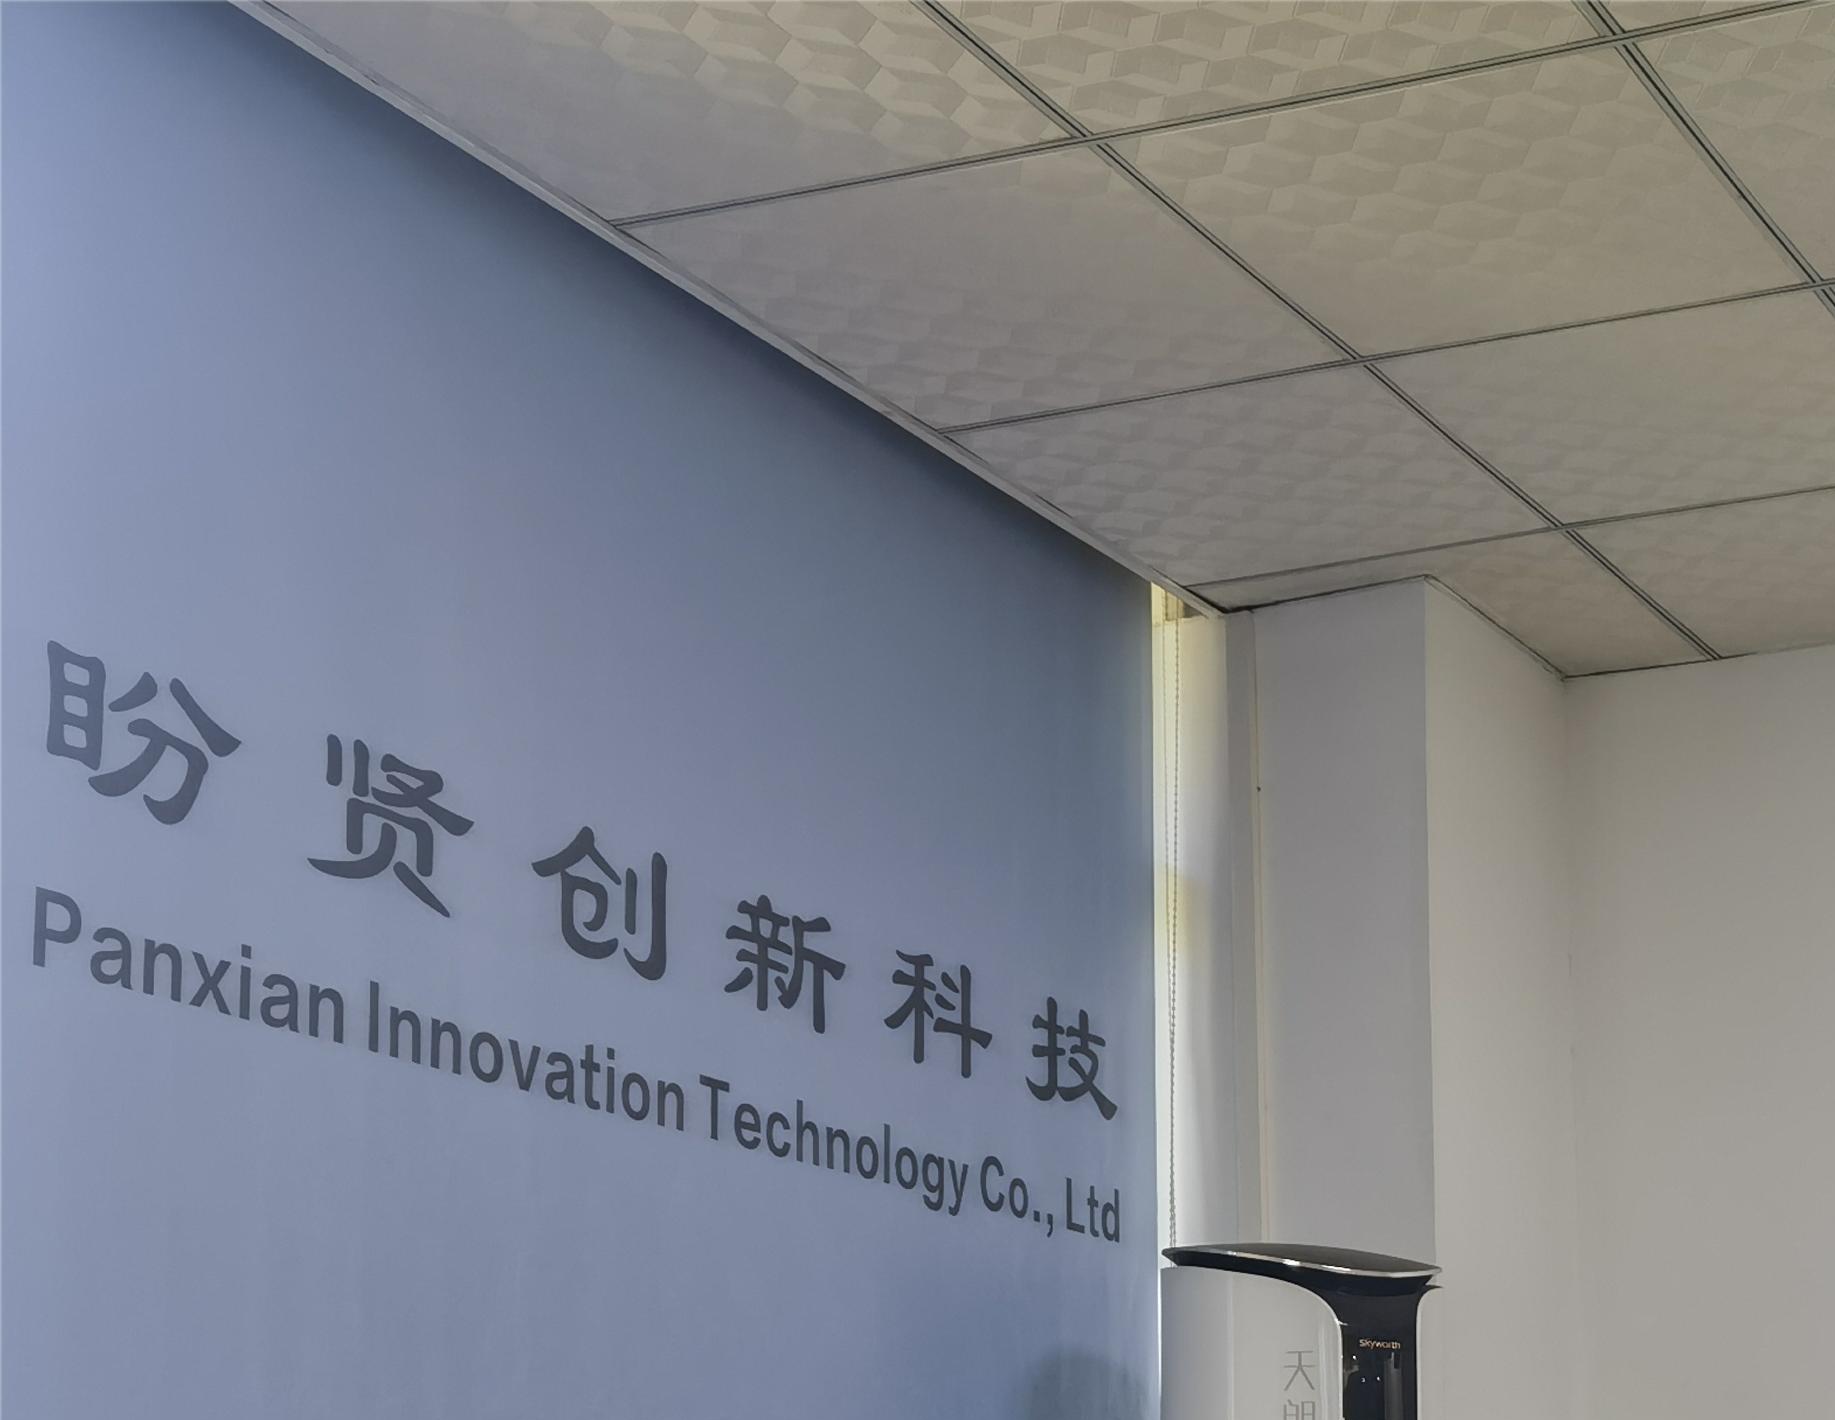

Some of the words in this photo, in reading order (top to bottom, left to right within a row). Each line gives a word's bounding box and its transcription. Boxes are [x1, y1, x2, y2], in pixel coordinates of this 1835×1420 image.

[46, 640, 1119, 1120] 盼贤创新科技
[32, 886, 345, 1045] Panxian
[367, 979, 686, 1132] Innovation
[698, 1073, 970, 1217] Technology
[1064, 1176, 1121, 1244] Ltd
[1359, 1338, 1401, 1350] Skyworth
